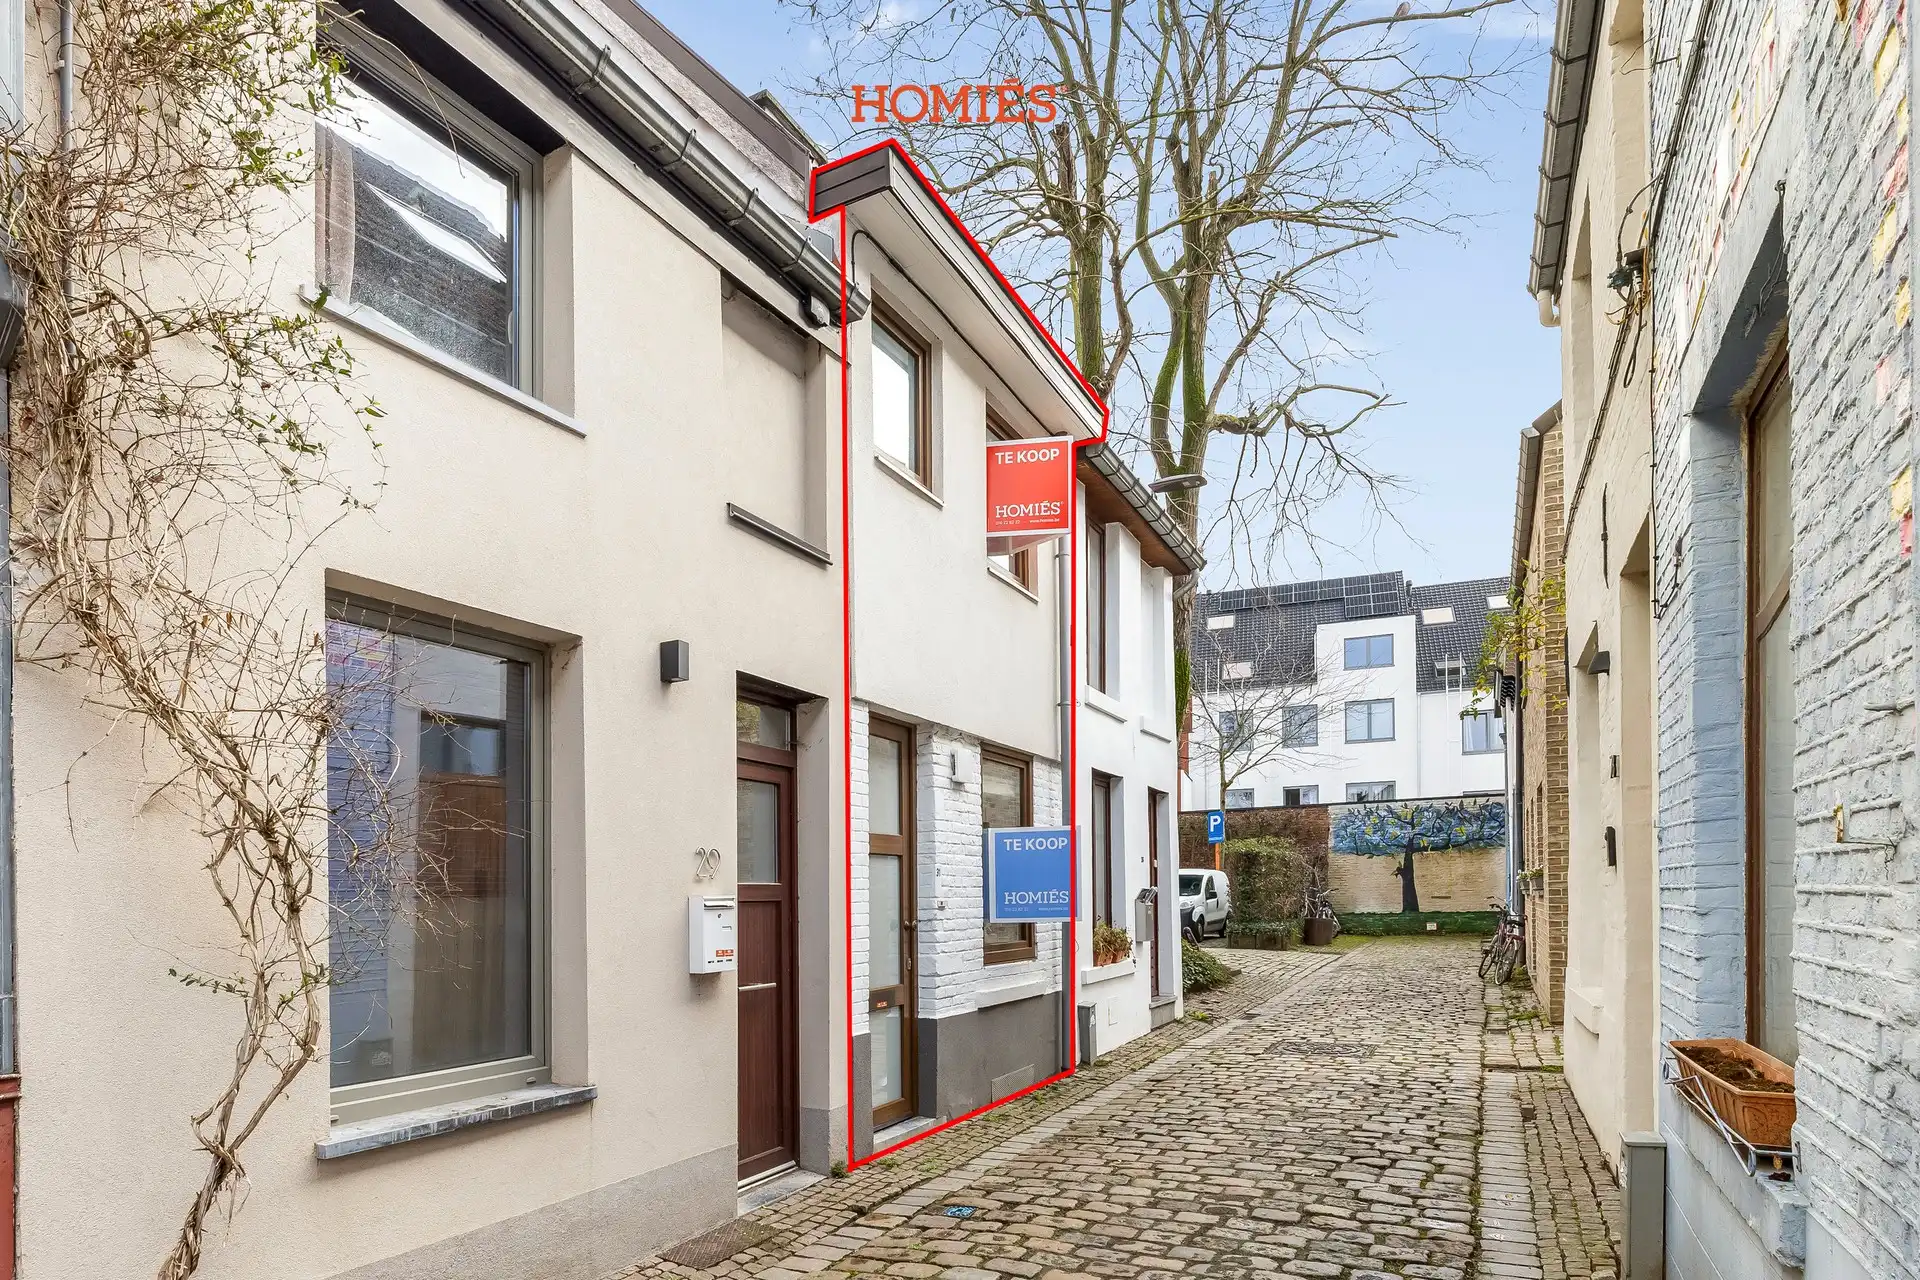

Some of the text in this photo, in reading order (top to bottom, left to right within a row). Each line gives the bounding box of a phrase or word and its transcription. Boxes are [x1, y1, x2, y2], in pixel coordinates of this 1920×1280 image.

[994, 448, 1060, 465] TE KOOP
[995, 501, 1061, 518] HOMIÉS
[1210, 815, 1222, 832] P
[1003, 837, 1068, 851] TE KOOP
[696, 847, 721, 879] 29
[1004, 889, 1069, 904] HOMIÉS
